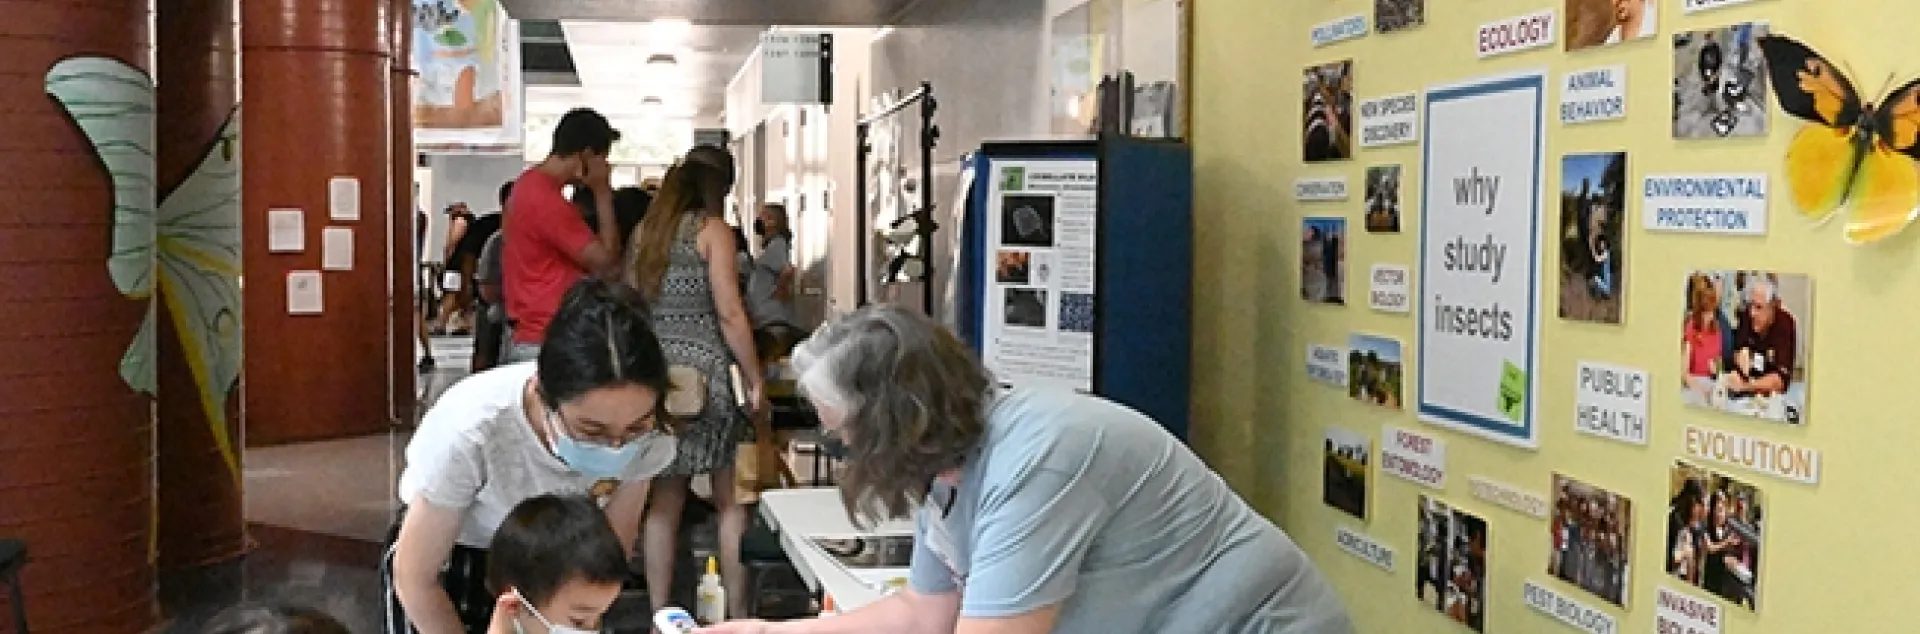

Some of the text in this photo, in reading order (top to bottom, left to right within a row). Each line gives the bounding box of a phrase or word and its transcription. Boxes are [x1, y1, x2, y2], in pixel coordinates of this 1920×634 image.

[1480, 15, 1551, 52] ECOLOGY
[1568, 69, 1614, 90] ANIMAL
[1381, 95, 1415, 115] SPECIES
[1560, 96, 1623, 120] BEHAVIOR
[1364, 122, 1411, 143] DISCOVERY
[1453, 167, 1500, 214] why
[1645, 178, 1764, 199] ENVIRONMENTAL
[1657, 208, 1748, 229] PROTECTION
[1444, 233, 1507, 282] study
[1374, 268, 1404, 285] VECTOR
[1371, 291, 1406, 306] BIOLOGY
[1435, 294, 1512, 341] insects
[1582, 367, 1643, 400] PUBLIC
[1577, 405, 1643, 439] HEALTH
[1397, 429, 1433, 453] FOREST
[1686, 427, 1812, 477] EVOLUTION
[1382, 452, 1442, 483] ENTOMOLOGY
[1338, 529, 1393, 568] AGRICULTURE
[1524, 583, 1614, 634] PEST BIOLOGY
[1657, 590, 1717, 628] INVASIVE
